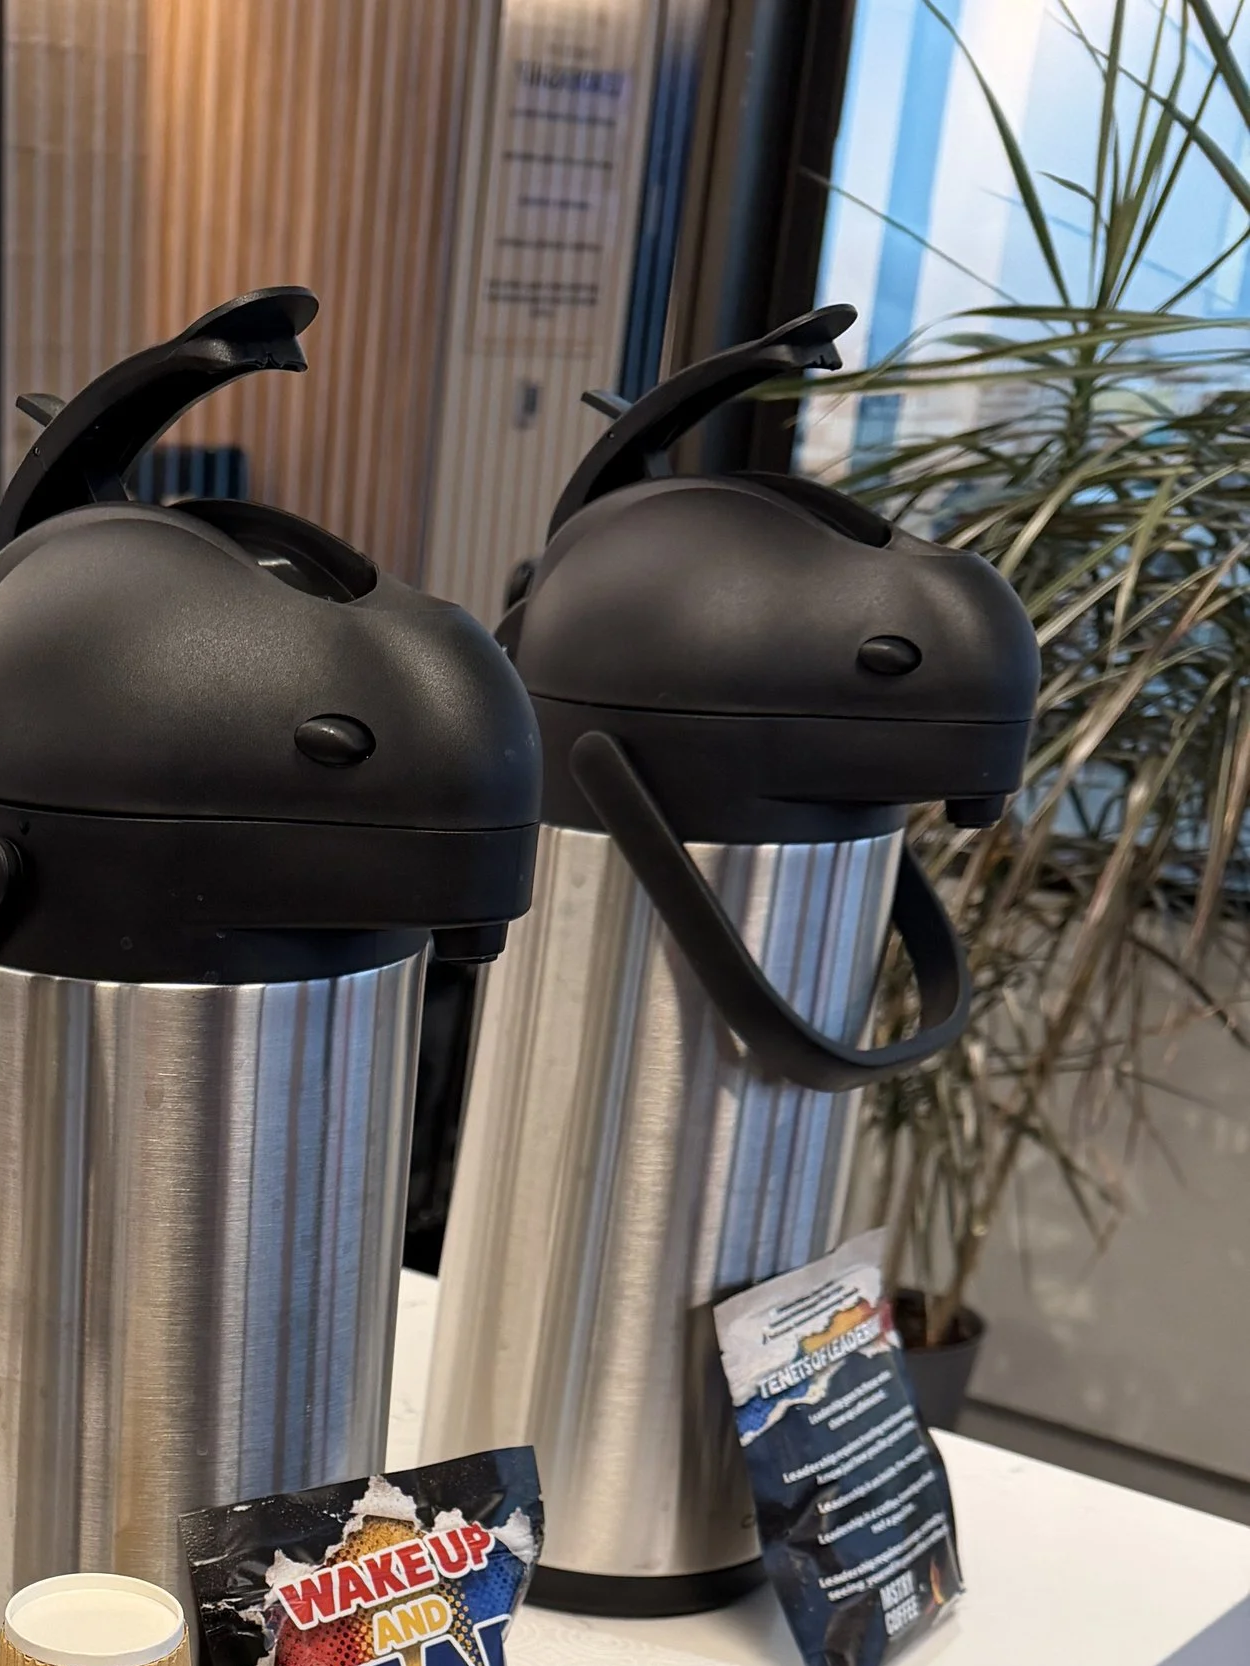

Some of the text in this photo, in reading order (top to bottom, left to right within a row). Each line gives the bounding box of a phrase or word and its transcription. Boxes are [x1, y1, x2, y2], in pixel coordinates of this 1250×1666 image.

[278, 1521, 496, 1630] WAKE UP
[372, 1593, 452, 1659] AND
